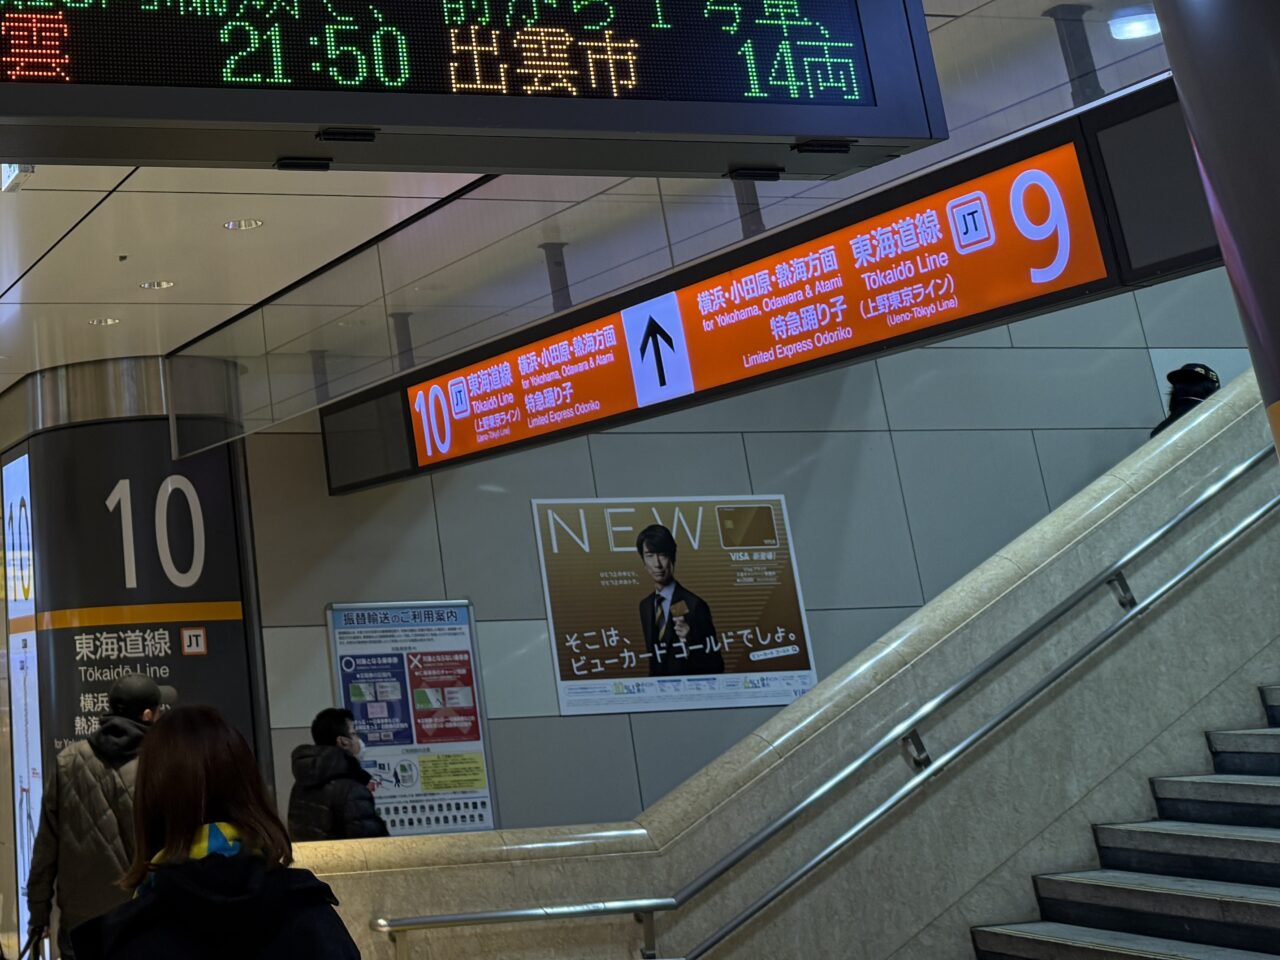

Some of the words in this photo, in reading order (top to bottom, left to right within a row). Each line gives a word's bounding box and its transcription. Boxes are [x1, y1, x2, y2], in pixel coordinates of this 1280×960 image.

[220, 21, 410, 86] 21:50
[451, 24, 639, 97] 出雲市
[738, 40, 859, 99] 14両
[849, 208, 943, 269] 東海道線
[960, 210, 979, 236] JT
[1010, 168, 1071, 284] 9
[696, 245, 839, 316] 横浜・小田原・熱海方面
[861, 259, 916, 291] Tōkaidō
[919, 249, 949, 275] Line
[702, 318, 715, 332] for
[715, 304, 761, 327] Yokohama,
[763, 291, 803, 312] Odawara
[805, 286, 813, 298] &
[815, 274, 842, 295] Atami
[769, 295, 848, 341] 特急踊り子
[938, 296, 958, 312] Line)
[743, 347, 774, 368] Limited
[776, 337, 812, 360] Express
[815, 325, 852, 348] Odoriko
[455, 389, 463, 407] JT
[467, 361, 514, 397] 東海道線
[499, 392, 514, 405] Line
[414, 384, 451, 456] 10
[549, 409, 574, 424] Express
[105, 474, 206, 590] 10
[547, 506, 703, 554] NEW
[729, 552, 750, 560] VISA
[74, 628, 171, 661] 東海道線
[187, 634, 201, 648] JT
[565, 626, 631, 654] そこは、
